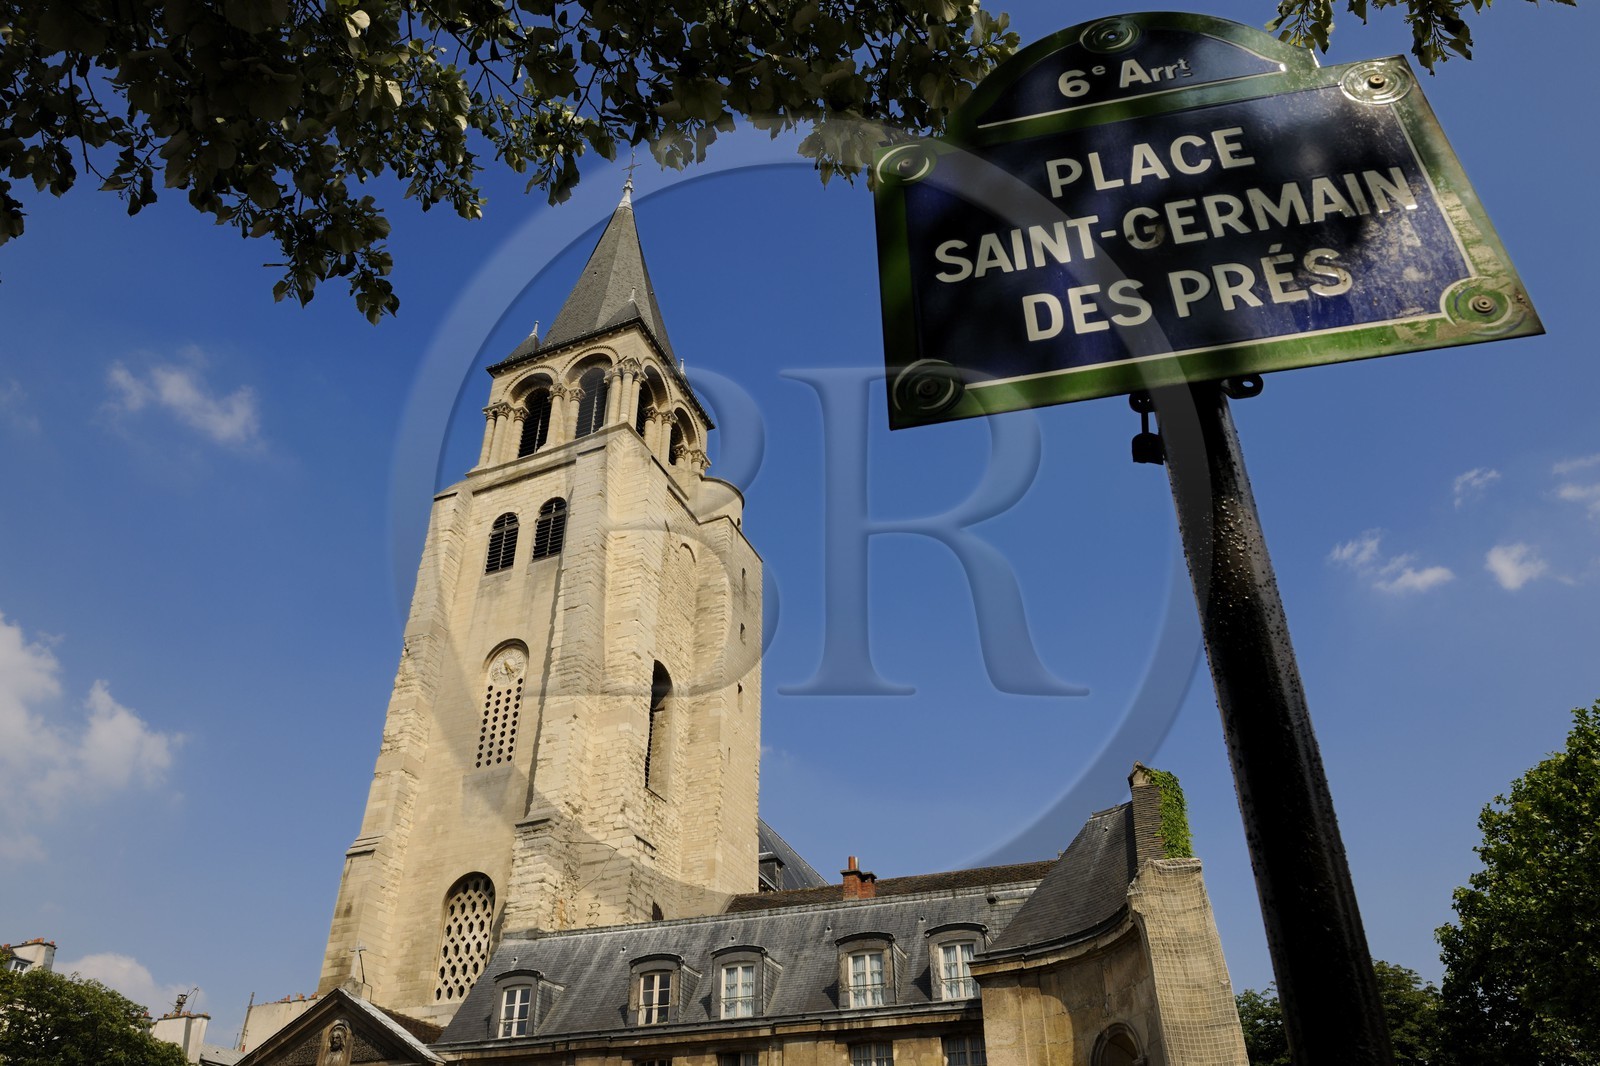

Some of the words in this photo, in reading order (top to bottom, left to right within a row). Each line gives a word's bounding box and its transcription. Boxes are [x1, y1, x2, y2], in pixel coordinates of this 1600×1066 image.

[1046, 127, 1255, 198] PLACE
[934, 167, 1418, 283] SAINT-GERMAIN
[1023, 280, 1152, 342] DES
[1168, 243, 1354, 318] PRÉS
